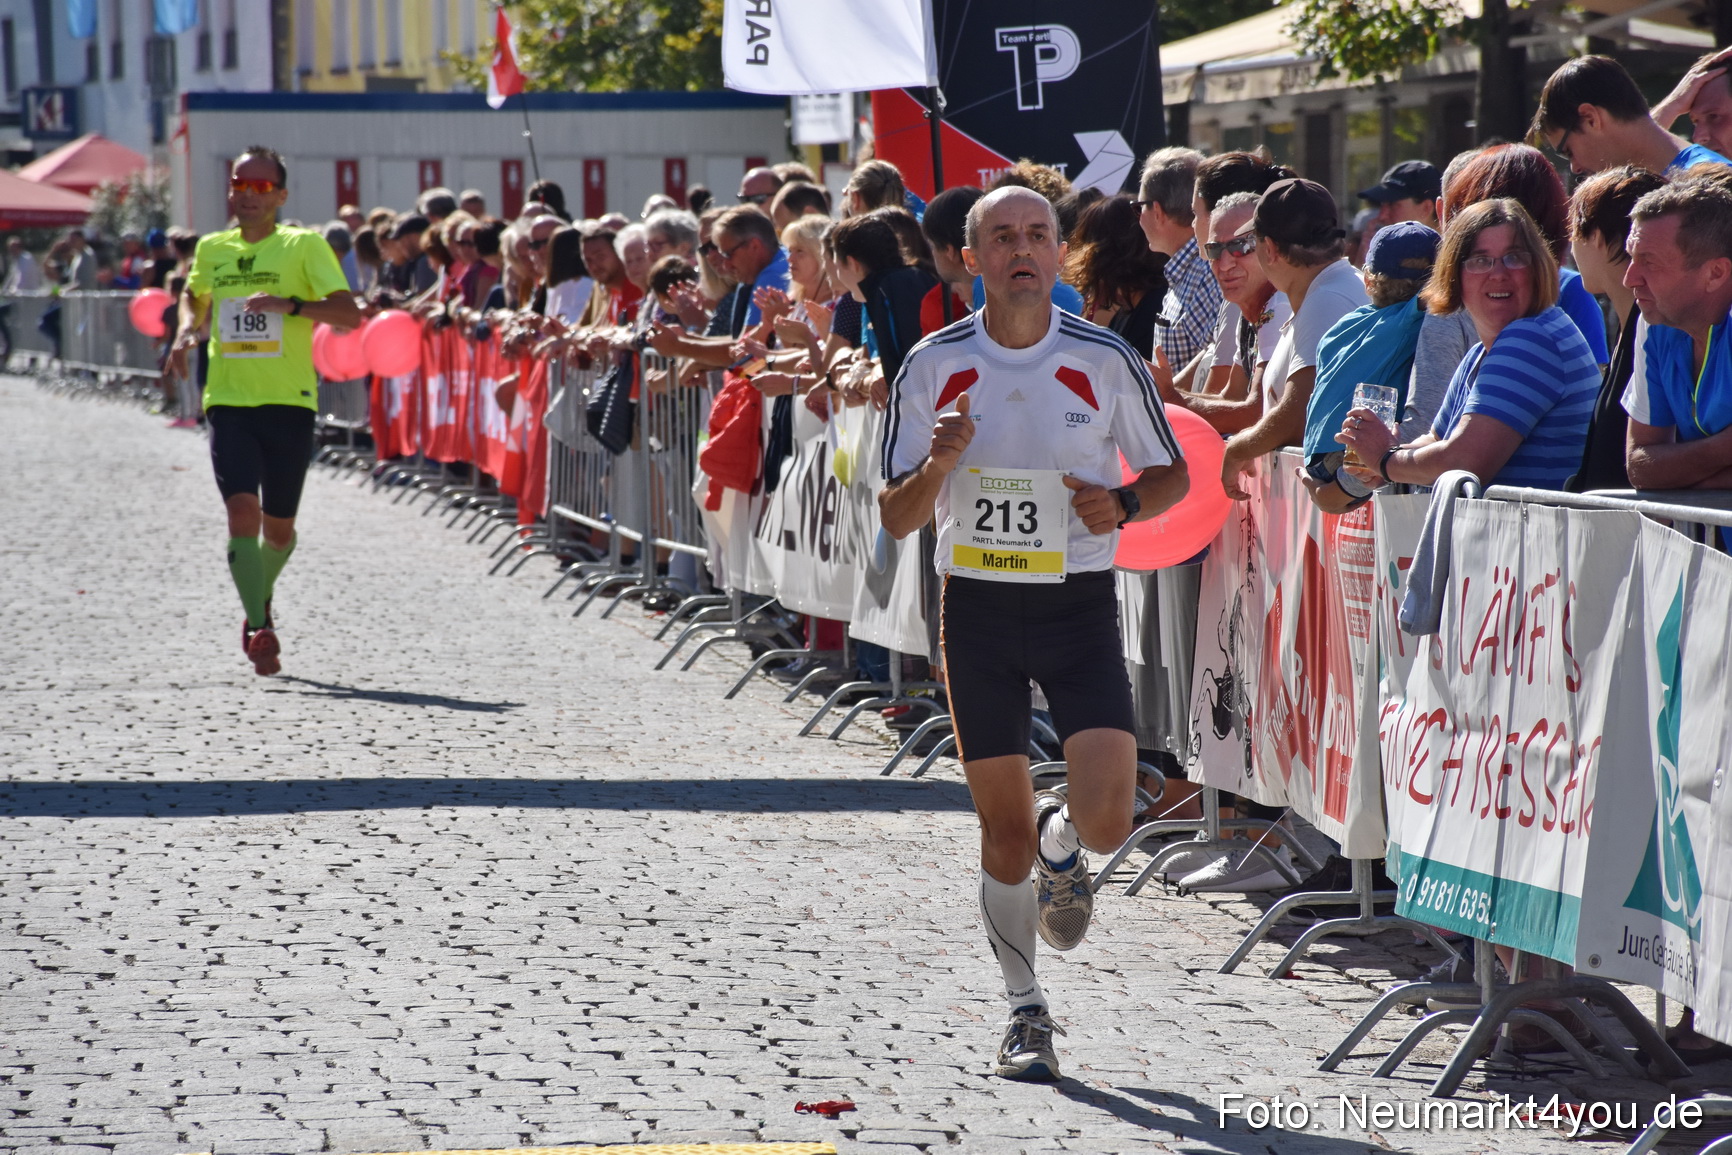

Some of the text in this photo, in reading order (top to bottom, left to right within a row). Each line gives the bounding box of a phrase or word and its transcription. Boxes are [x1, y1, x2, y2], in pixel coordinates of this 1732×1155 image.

[1002, 33, 1027, 44] Team
[233, 313, 268, 333] 198
[980, 476, 1033, 492] BOCK
[975, 498, 1038, 535] 213
[972, 535, 1031, 547] PARTL Neumarkt
[982, 552, 1028, 570] Martin
[1406, 873, 1418, 903] 0
[1617, 925, 1650, 962] Jura
